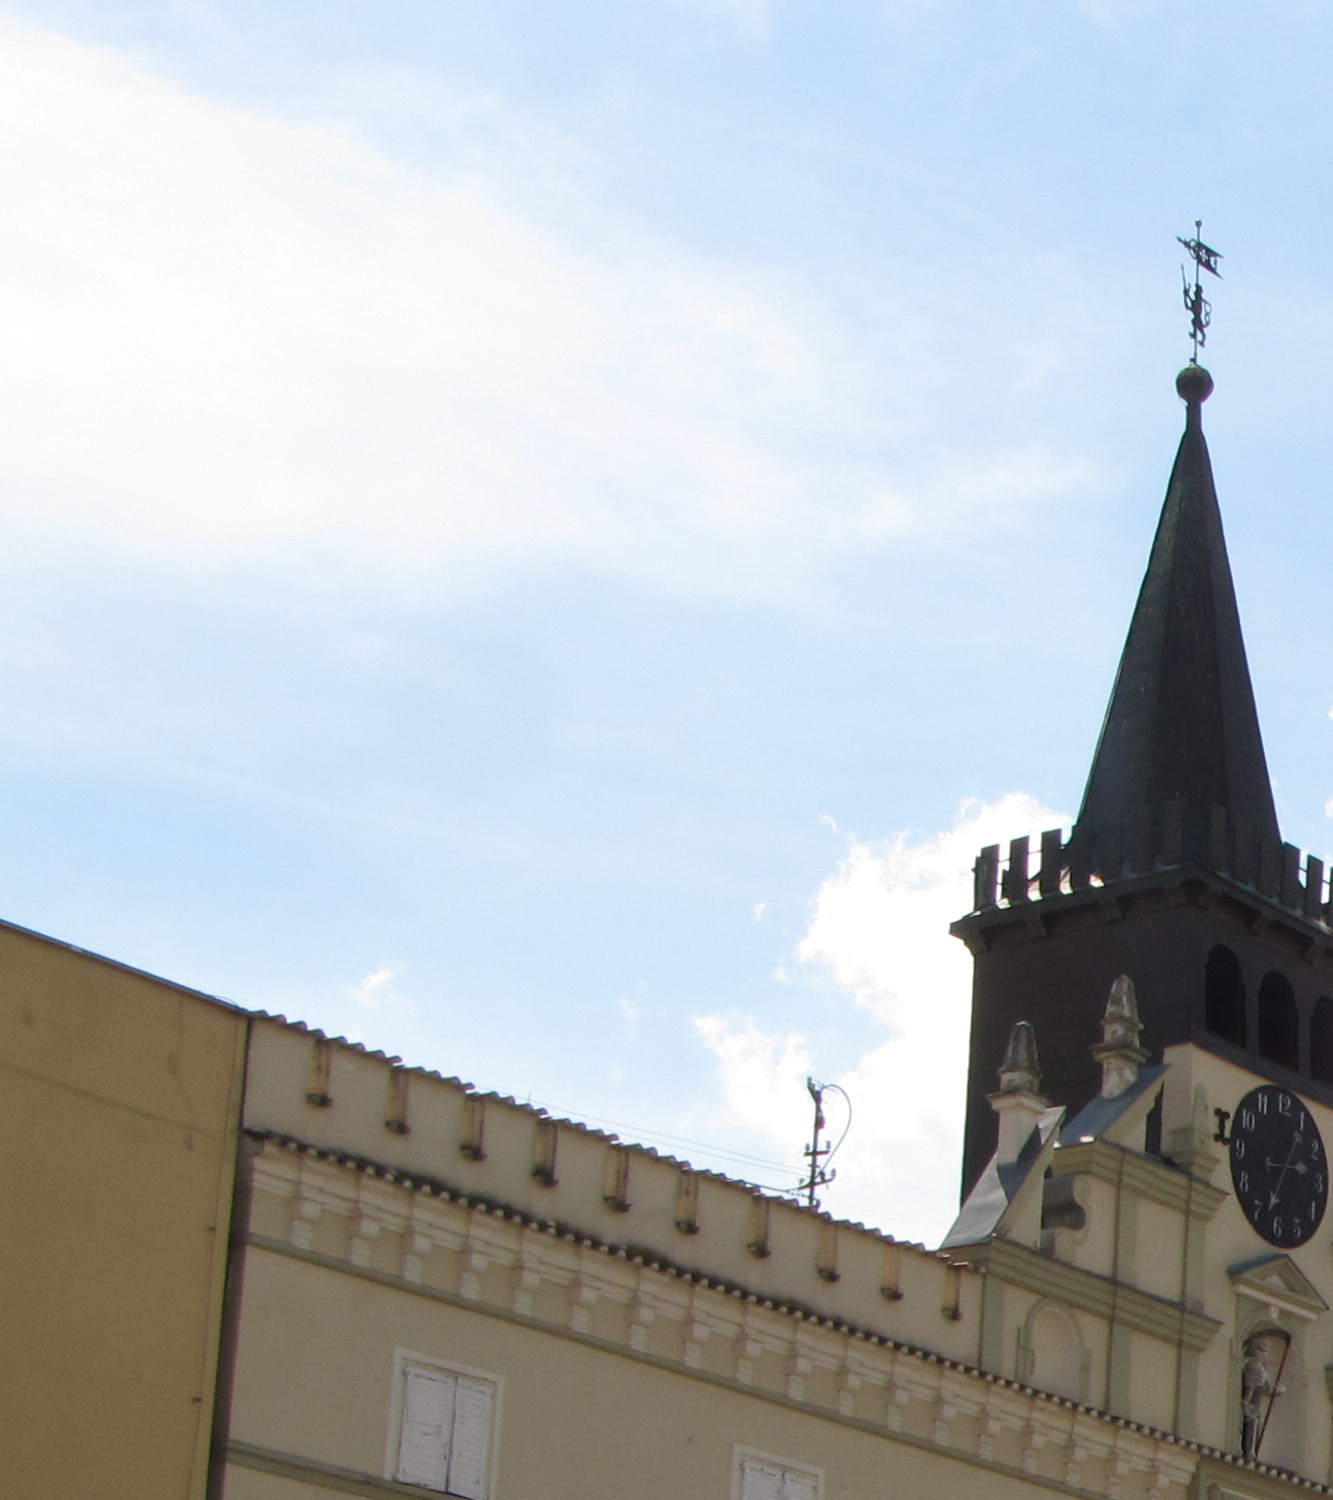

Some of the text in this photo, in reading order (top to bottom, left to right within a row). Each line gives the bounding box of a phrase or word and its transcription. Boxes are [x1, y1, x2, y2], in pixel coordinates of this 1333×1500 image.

[1257, 1092, 1268, 1115] 11
[1278, 1093, 1292, 1118] 12
[1241, 1108, 1256, 1133] 10
[1299, 1111, 1305, 1132] 1
[1235, 1138, 1245, 1160] 9
[1310, 1139, 1319, 1161] 2
[1239, 1170, 1249, 1193] 8
[1314, 1172, 1324, 1194] 3
[1253, 1198, 1264, 1221] 7
[1273, 1216, 1283, 1237] 6
[1293, 1216, 1302, 1237] 5
